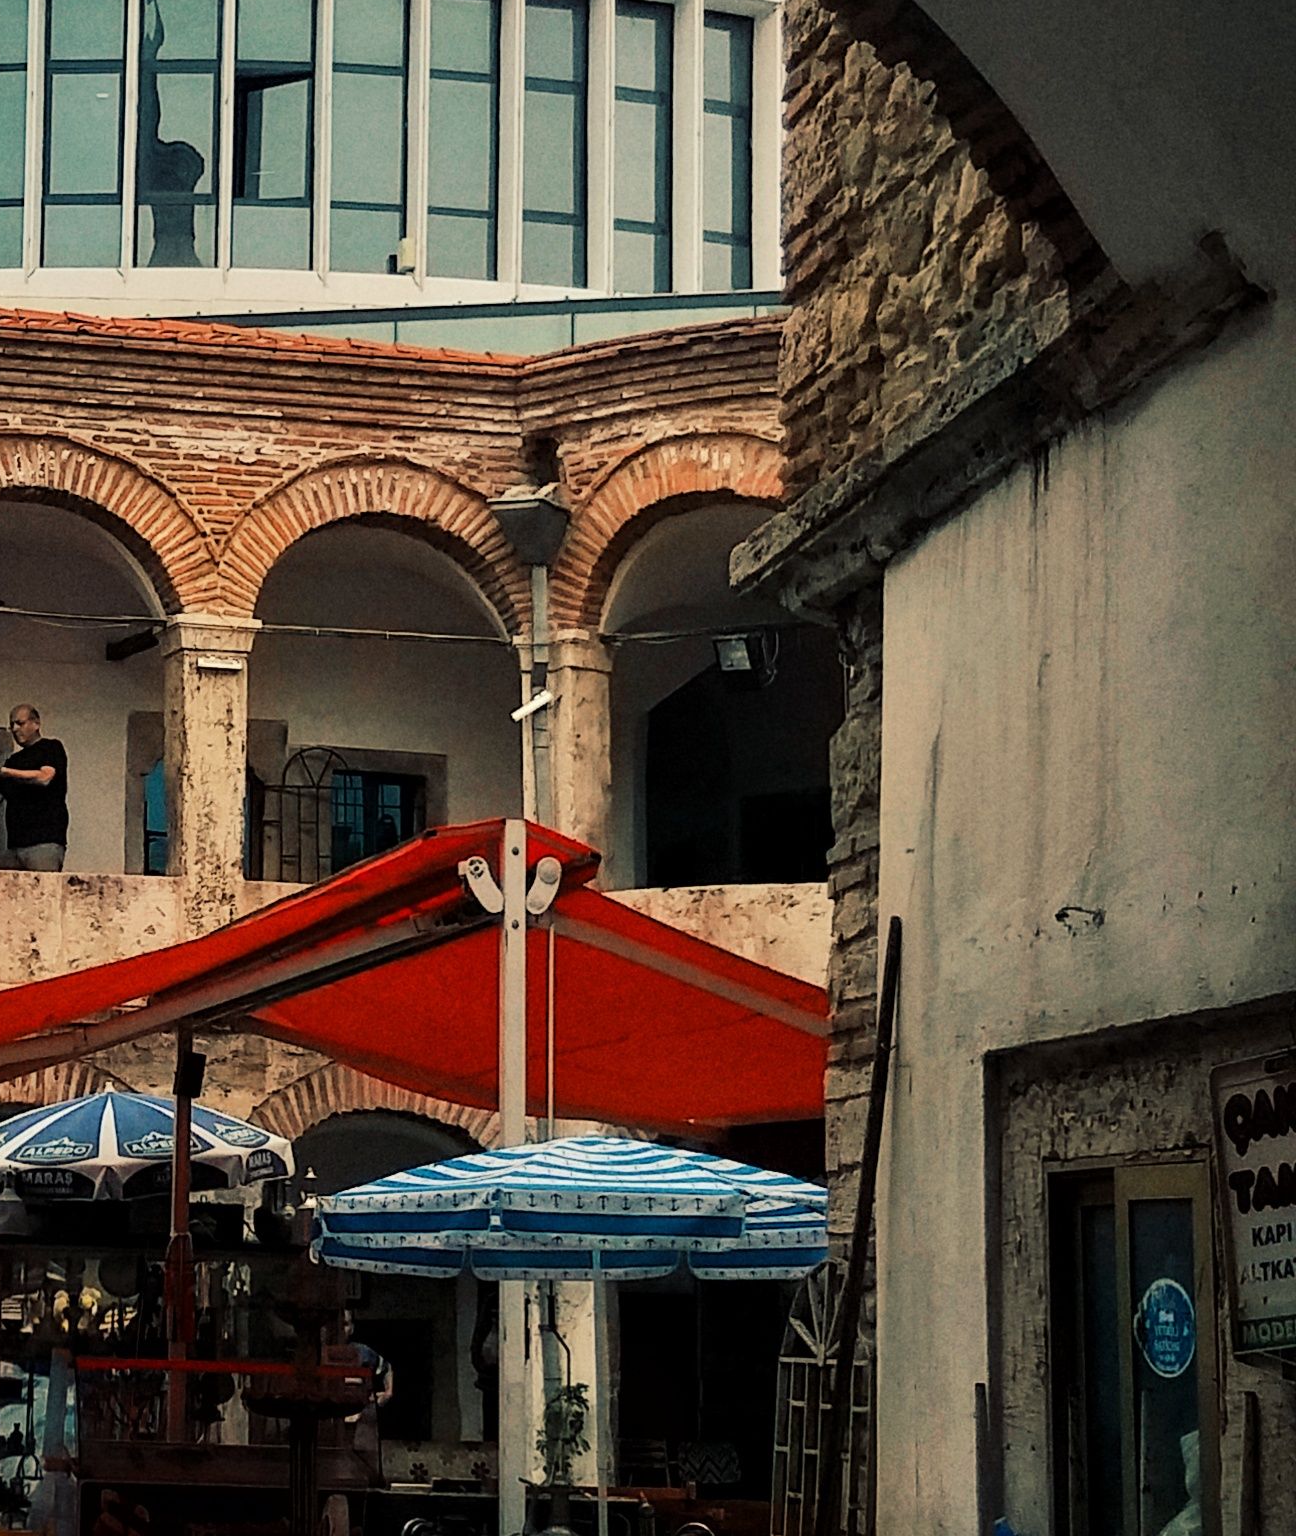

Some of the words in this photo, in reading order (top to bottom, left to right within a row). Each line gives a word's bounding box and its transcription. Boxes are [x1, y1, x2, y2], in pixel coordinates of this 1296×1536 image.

[22, 1146, 86, 1156] ALPEDO
[1252, 1222, 1292, 1247] KAPI
[1242, 1315, 1296, 1344] MODE
